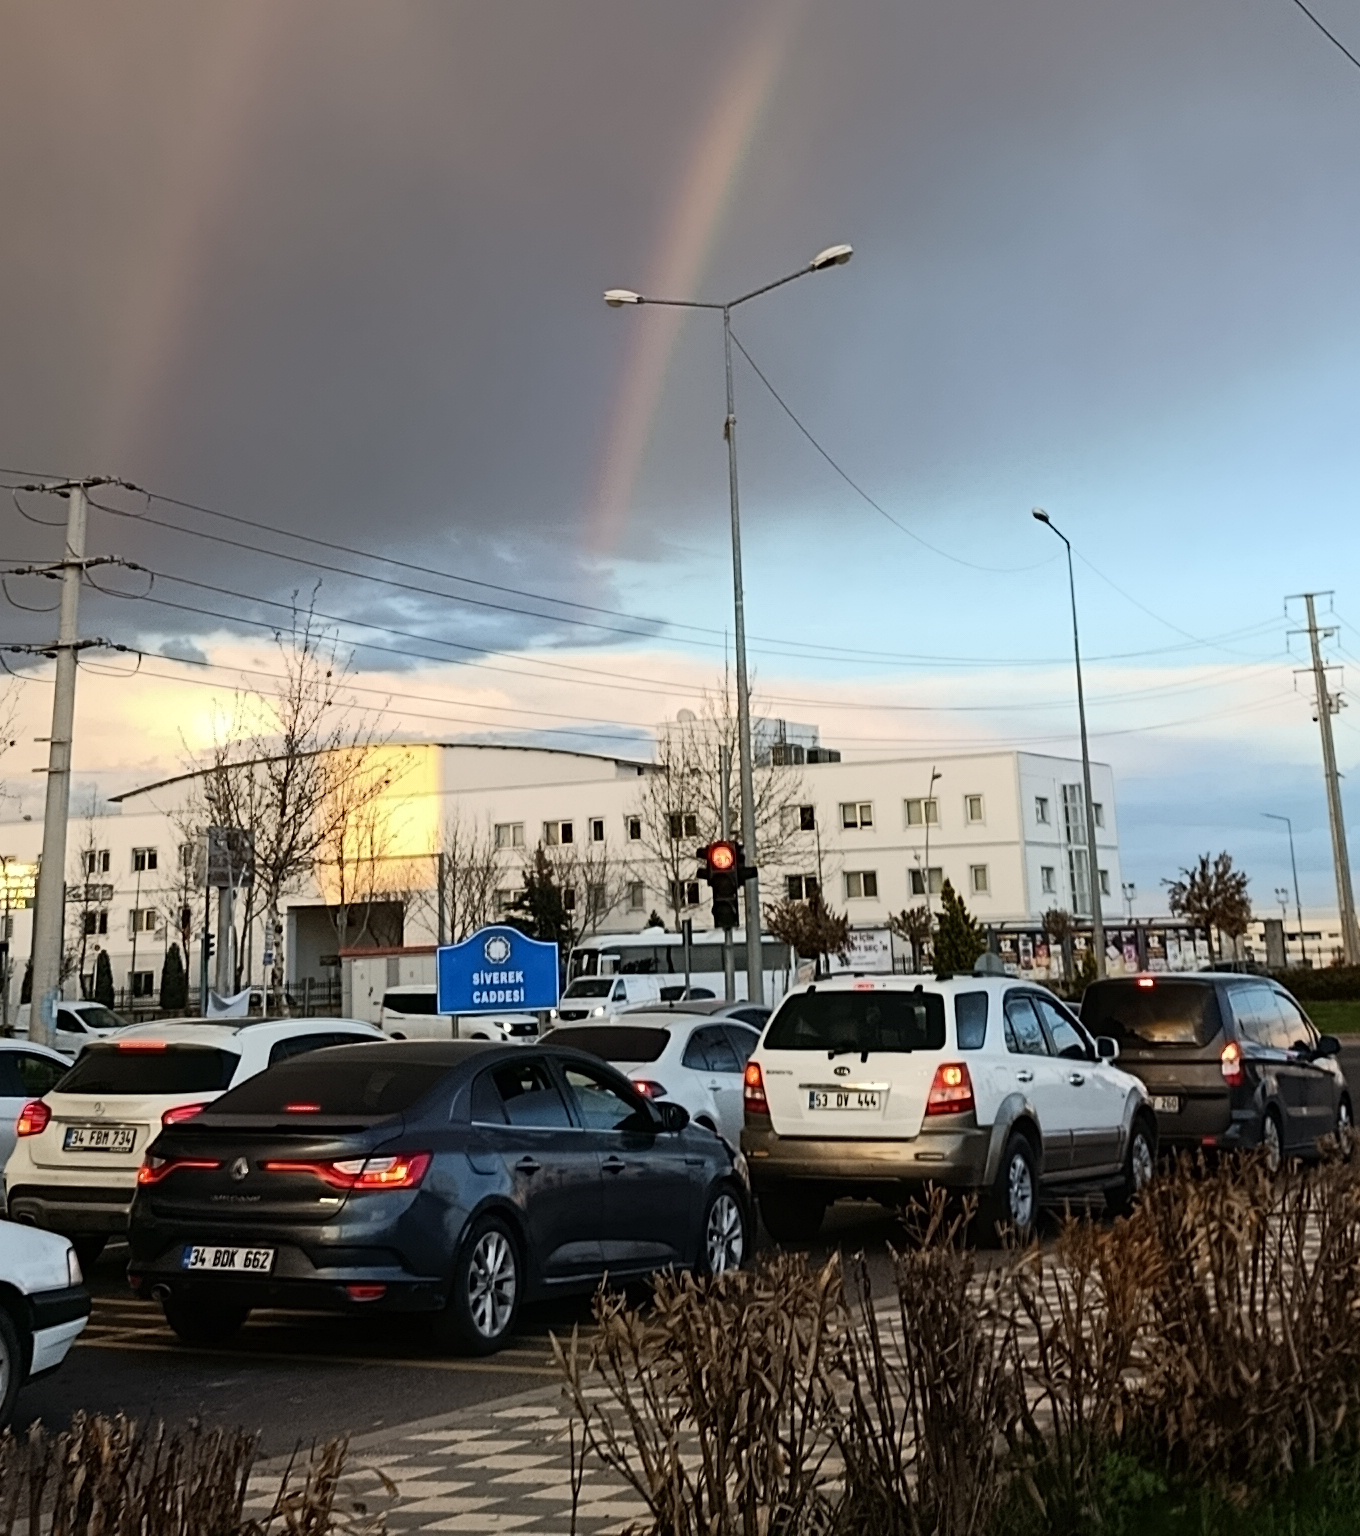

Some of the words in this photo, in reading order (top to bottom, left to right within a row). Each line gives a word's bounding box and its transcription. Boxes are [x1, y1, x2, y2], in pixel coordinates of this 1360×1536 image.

[472, 969, 524, 985] SİVEREK
[472, 986, 525, 1004] CADDESİ
[815, 1093, 828, 1107] 53
[858, 1094, 877, 1107] 444
[72, 1130, 84, 1144] 34
[89, 1131, 110, 1145] FBM
[113, 1131, 131, 1145] 734
[191, 1248, 206, 1266] 34
[212, 1249, 238, 1268] BDK
[243, 1251, 270, 1269] 662
